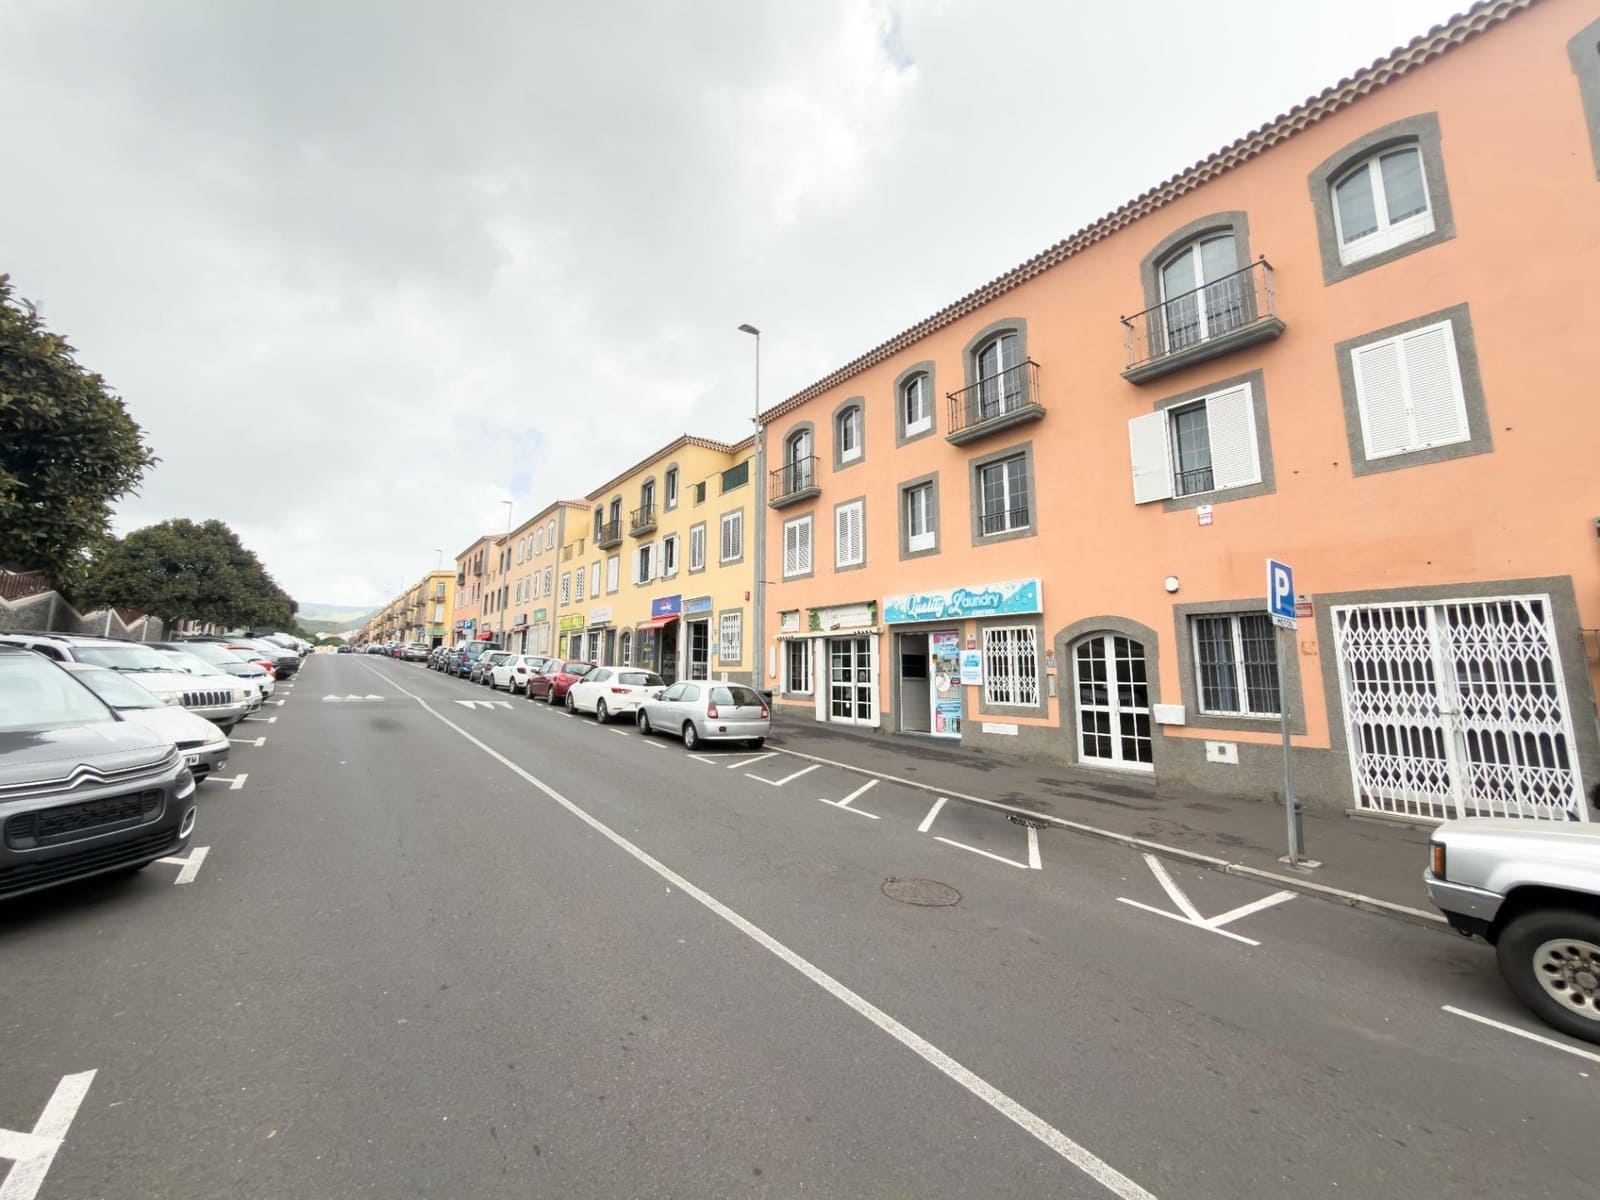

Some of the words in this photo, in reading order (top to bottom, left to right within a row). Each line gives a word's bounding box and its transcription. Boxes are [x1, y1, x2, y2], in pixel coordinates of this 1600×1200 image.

[907, 593, 944, 619] Quality
[948, 588, 999, 616] Laundry
[1275, 567, 1290, 610] P
